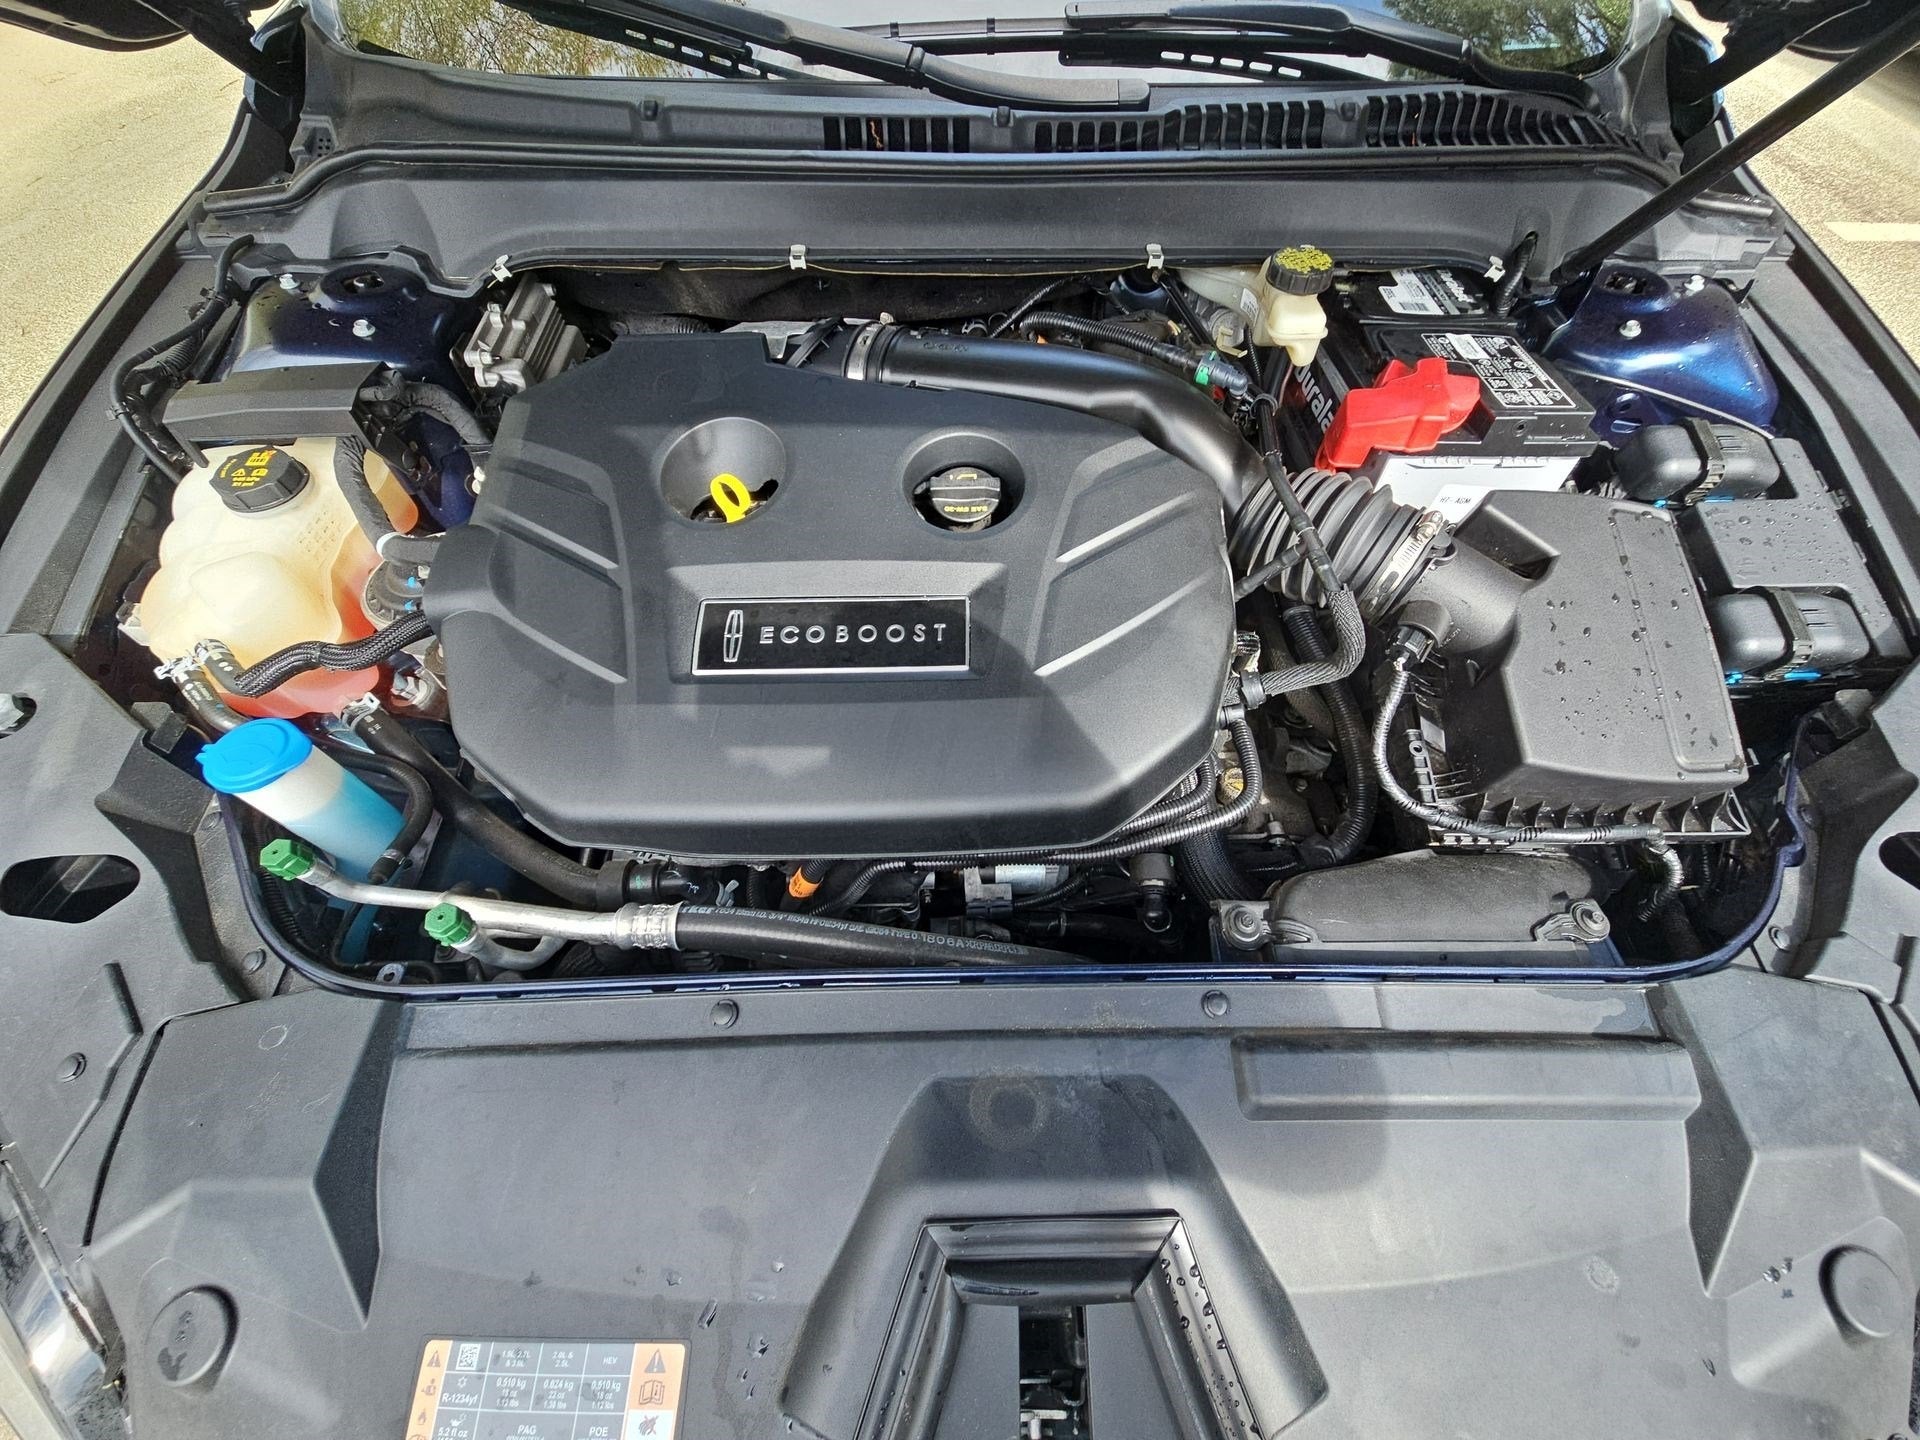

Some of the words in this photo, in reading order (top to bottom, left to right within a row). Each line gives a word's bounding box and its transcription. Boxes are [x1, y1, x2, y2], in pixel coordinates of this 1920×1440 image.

[1294, 364, 1335, 434] Durala
[759, 623, 946, 644] ECOBOOST
[680, 903, 715, 914] rker
[922, 934, 965, 949] 1806A
[603, 1356, 618, 1365] HEV
[516, 1377, 527, 1390] kg
[564, 1380, 574, 1391] kg
[612, 1381, 621, 1392] kg
[441, 1392, 479, 1406] R-1234yf
[438, 1426, 450, 1436] 5.2
[458, 1430, 468, 1438] oz
[518, 1424, 537, 1435] PAG
[589, 1426, 609, 1437] POE
